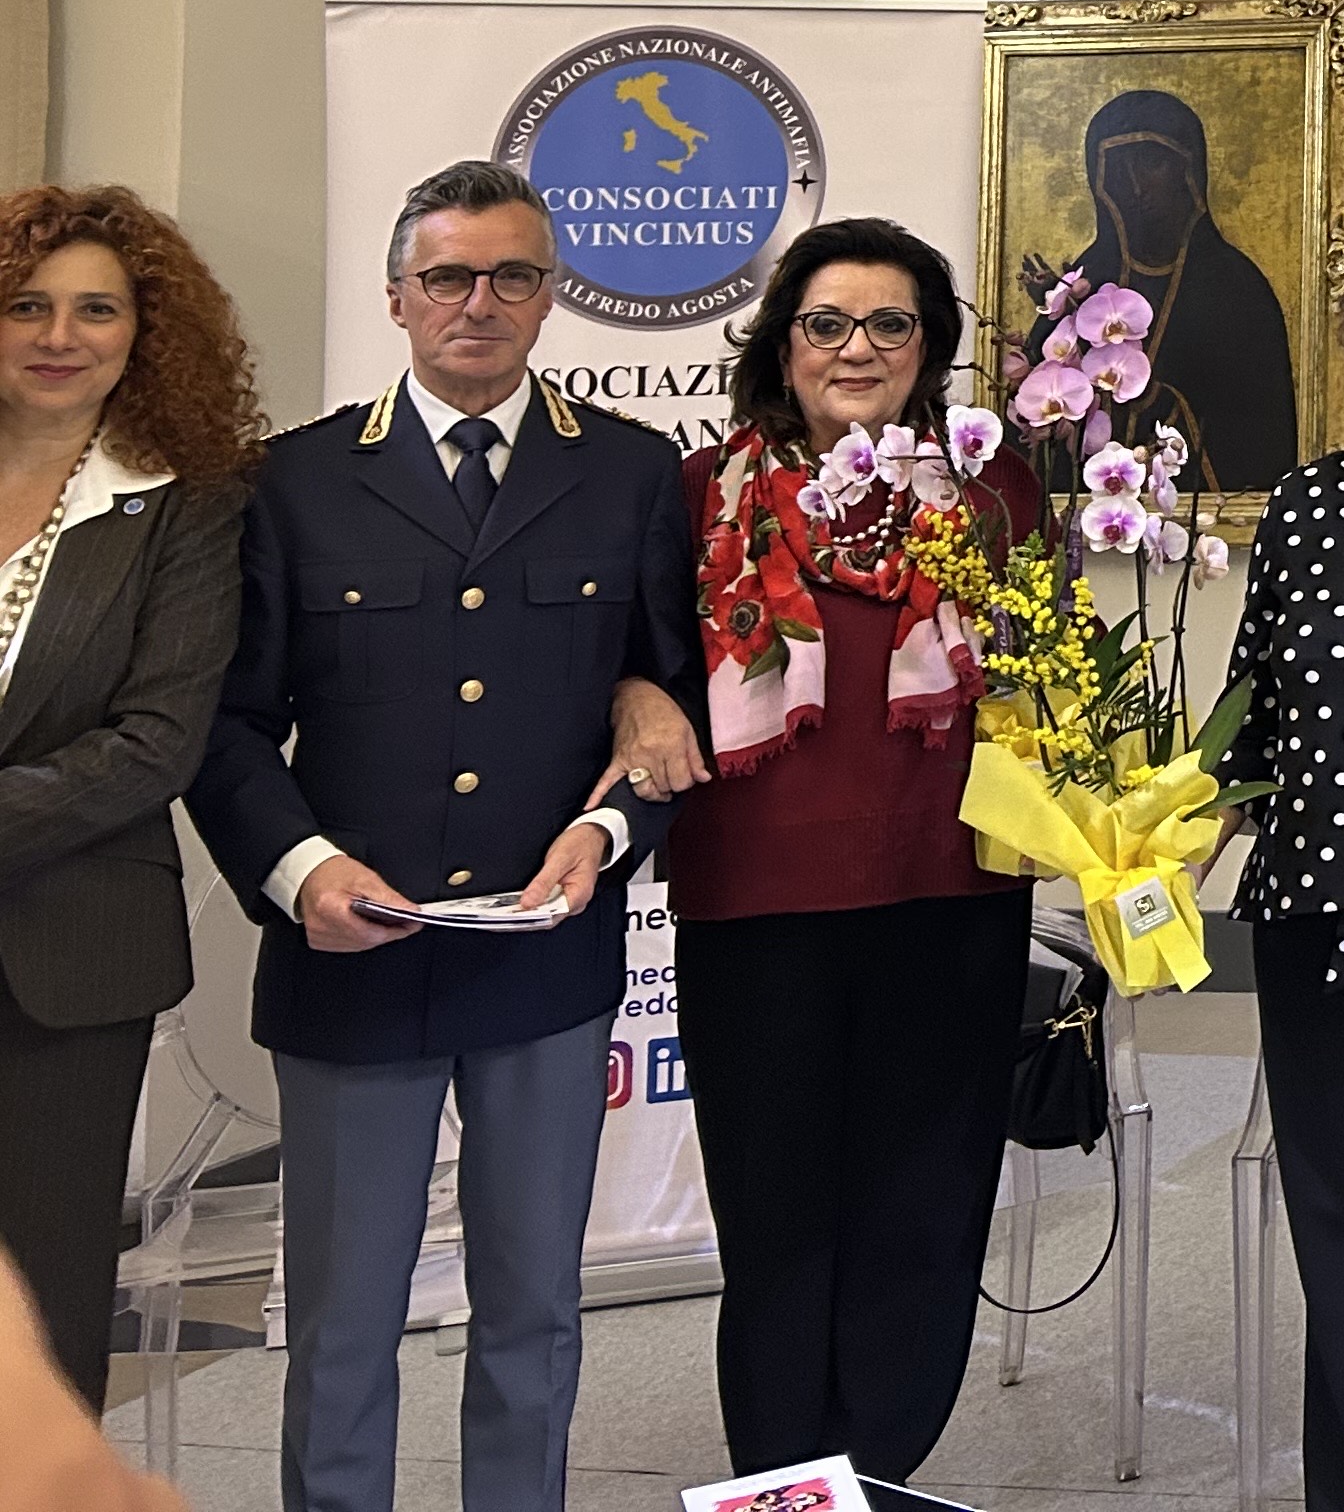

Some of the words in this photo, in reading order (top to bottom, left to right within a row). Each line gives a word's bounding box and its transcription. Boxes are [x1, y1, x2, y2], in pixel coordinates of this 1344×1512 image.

[506, 47, 616, 166] ASSOCIAZIONE
[618, 39, 747, 74] NAZIONALE
[745, 70, 811, 169] ANTIMAFIA
[542, 186, 778, 211] CONSOCIATI
[565, 221, 754, 246] VINCIMUS
[557, 278, 661, 319] ALFREDO
[666, 277, 755, 318] AGOSTA
